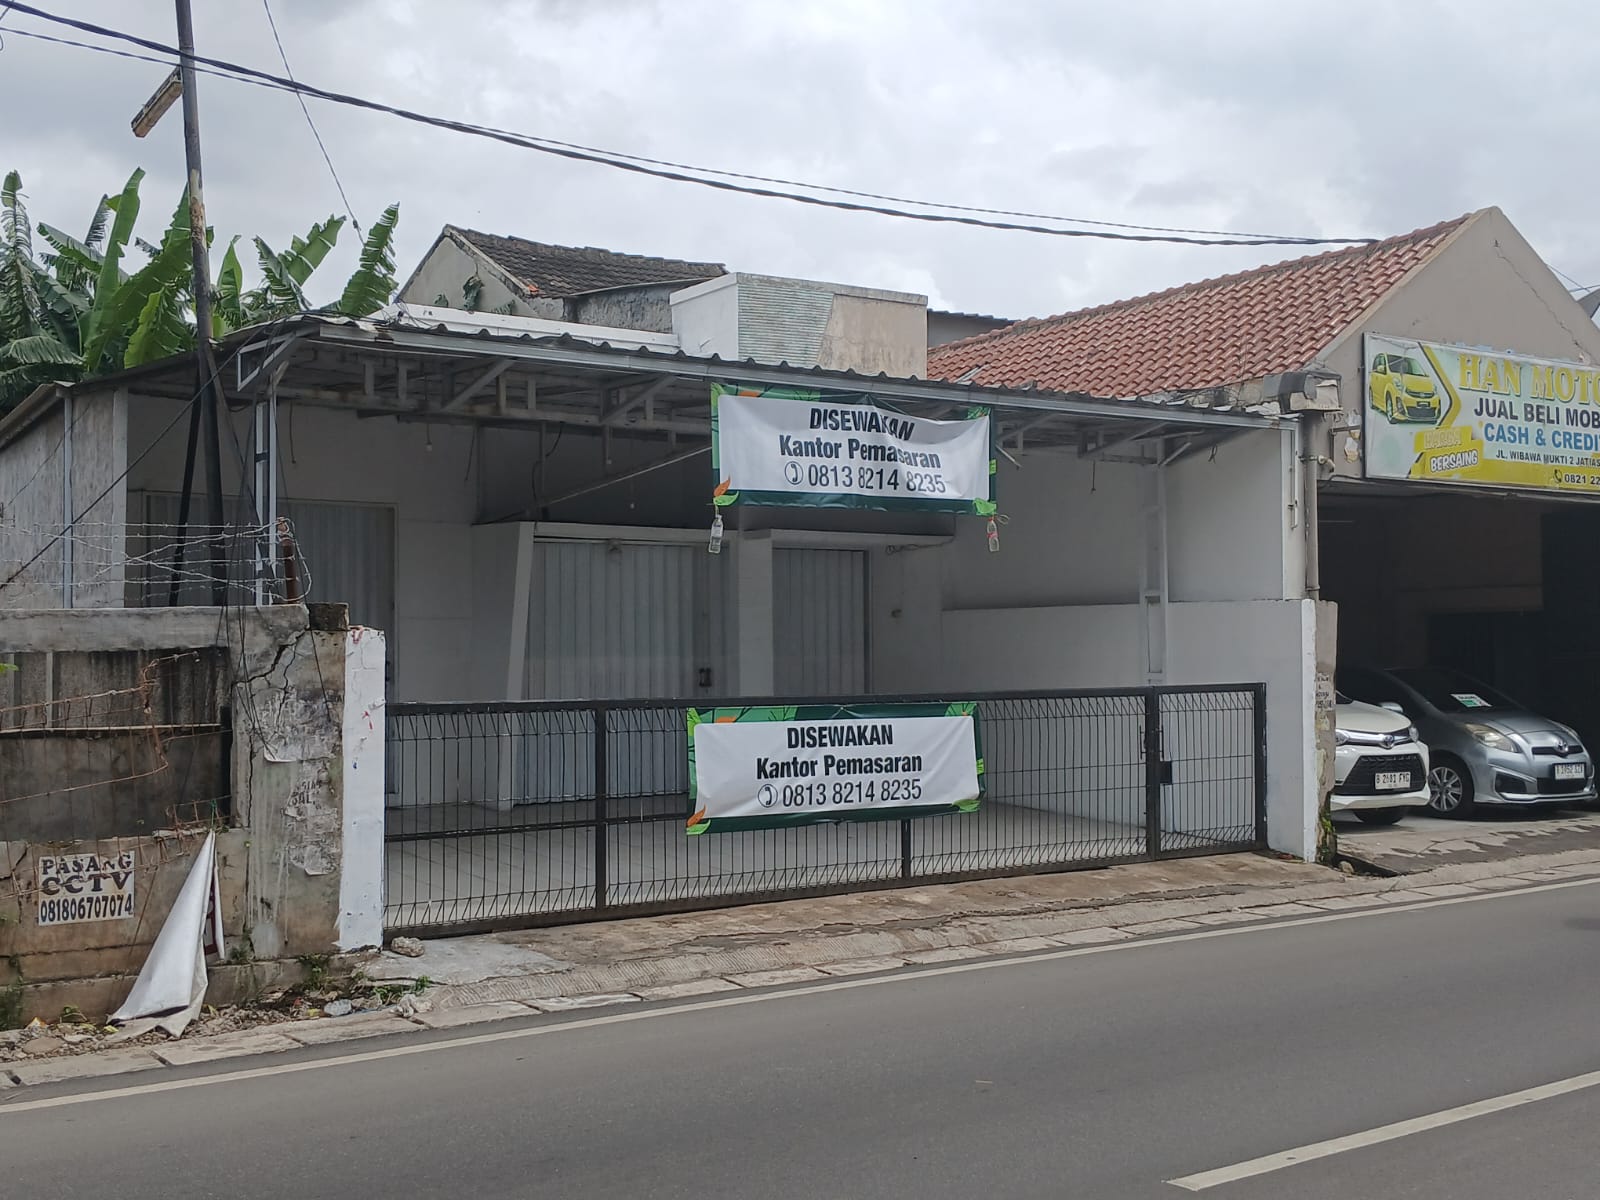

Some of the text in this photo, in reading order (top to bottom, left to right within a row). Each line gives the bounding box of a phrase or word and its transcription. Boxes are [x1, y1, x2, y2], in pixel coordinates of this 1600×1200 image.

[1458, 353, 1521, 397] HAN
[810, 408, 915, 441] DISEWAKAN
[1474, 398, 1519, 420] JUAL
[1523, 403, 1560, 425] BELI
[1484, 423, 1600, 452] CASH & CREDI
[779, 435, 941, 469] Kantor Pemasaran
[1430, 449, 1478, 473] BERSAING
[1496, 450, 1508, 460] JL.
[1510, 450, 1541, 462] WIBAWA
[1543, 454, 1568, 465] MUKTI
[1569, 456, 1574, 465] 2
[808, 464, 946, 494] 0813 8214 8235
[1564, 473, 1587, 484] 0821
[787, 725, 893, 749] DISEWAKAN
[757, 754, 922, 780] Kantor Pemasaran
[782, 778, 922, 807] 0813 8214 8235
[42, 854, 132, 875] PASANG
[42, 871, 133, 896] CCTV
[41, 893, 133, 923] 081806707074
